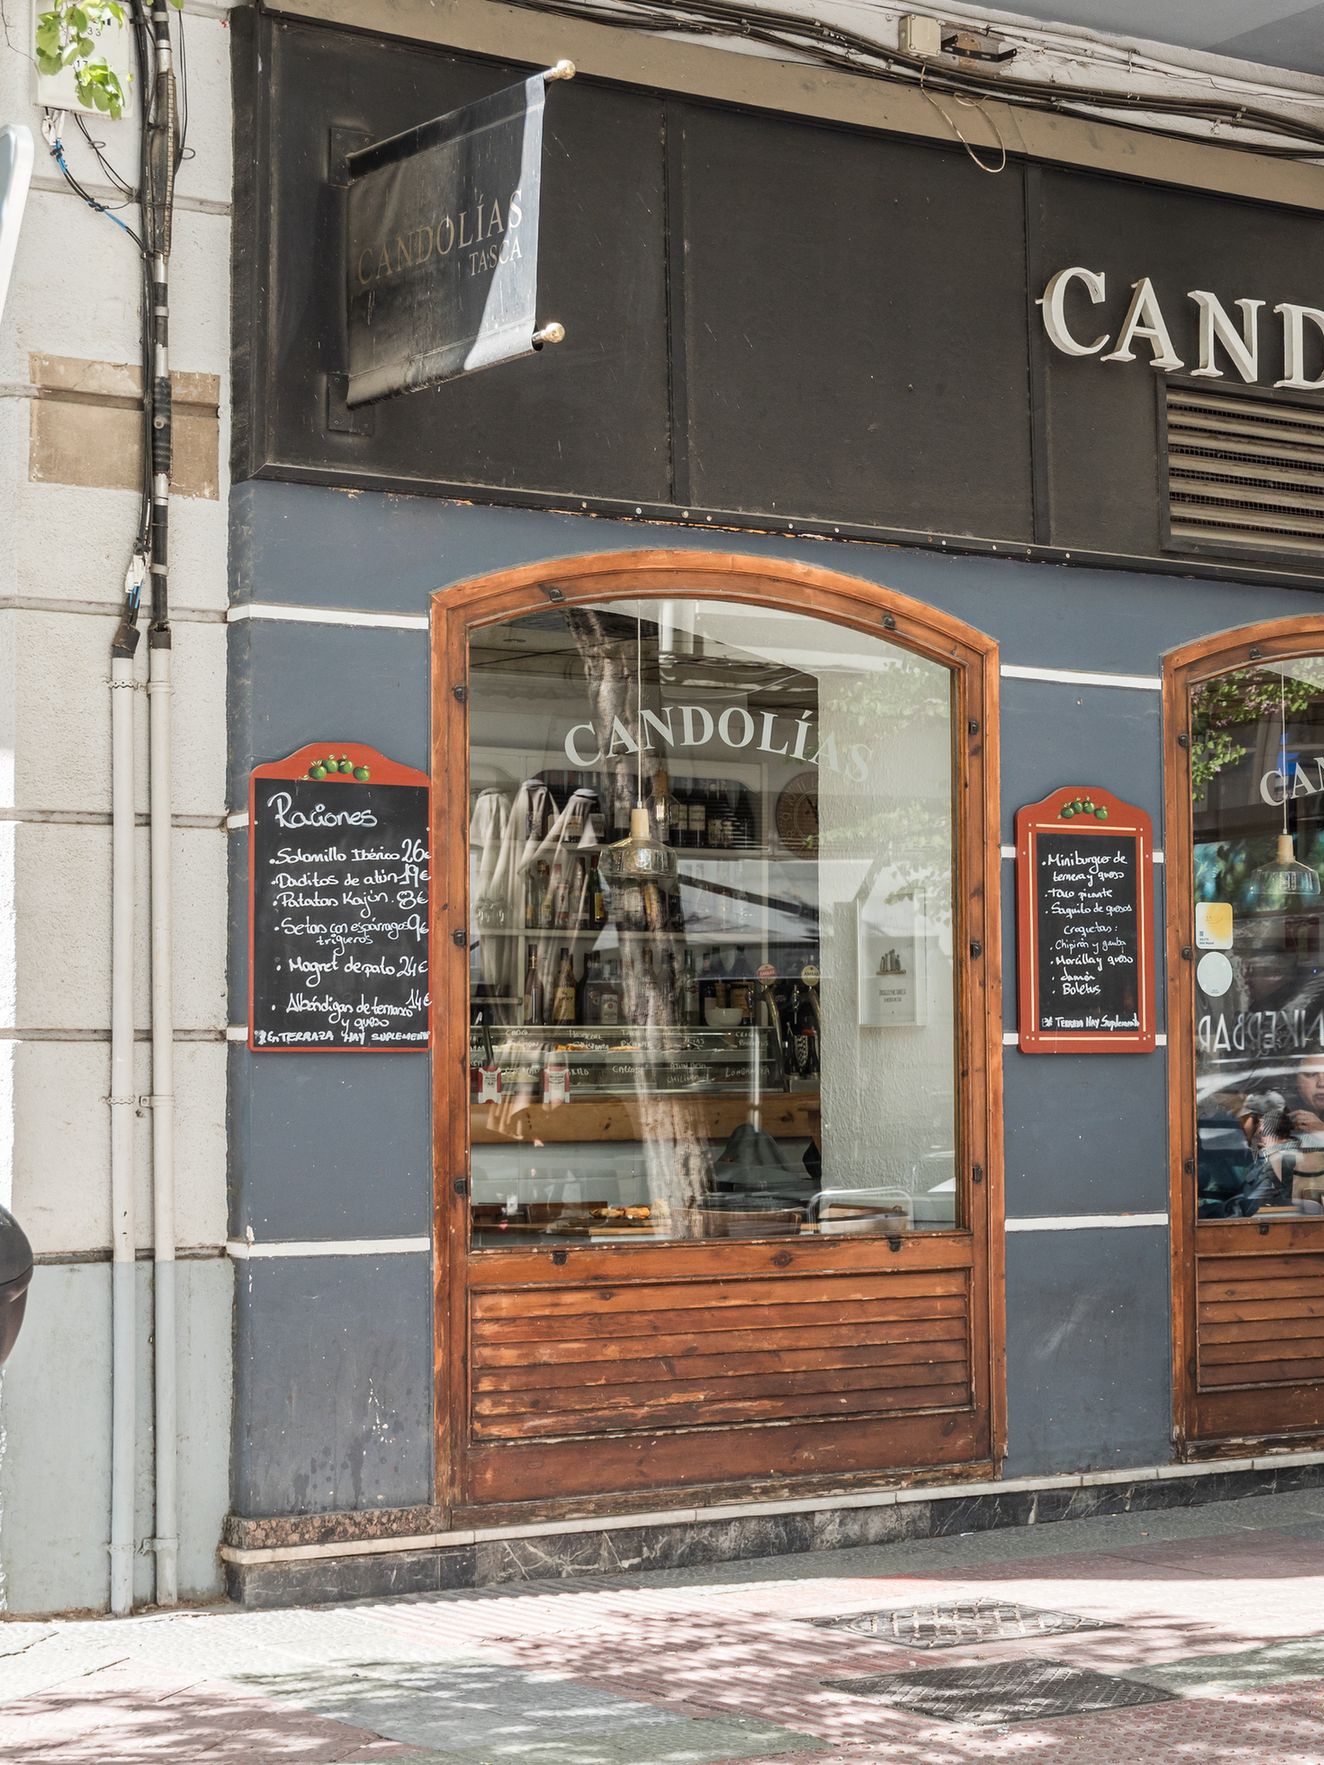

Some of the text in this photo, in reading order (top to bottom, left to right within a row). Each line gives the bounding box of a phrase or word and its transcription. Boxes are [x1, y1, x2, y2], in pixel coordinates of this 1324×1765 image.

[358, 189, 522, 284] CANDOLÍAS
[469, 235, 523, 276] TASCA
[564, 706, 873, 783] CANDOLÍAS
[267, 792, 378, 828] Raciones
[277, 847, 347, 864] Solomillo
[401, 838, 432, 863] 26€
[1113, 850, 1128, 864] de
[276, 872, 339, 889] Daditos
[344, 873, 360, 886] de
[1086, 874, 1093, 887] y
[1098, 871, 1125, 881] queso
[276, 891, 339, 907] Patatas
[396, 890, 428, 909] 8€
[1078, 888, 1113, 901] picante
[1093, 902, 1104, 913] de
[1105, 904, 1132, 917] quesos
[281, 916, 328, 935] Setas
[330, 924, 348, 934] con
[316, 934, 374, 956] trigueros
[1092, 942, 1099, 955] y
[289, 955, 340, 987] Magret
[396, 955, 428, 978] 24€
[1095, 957, 1103, 972] y
[1107, 955, 1134, 966] queso
[1062, 981, 1102, 996] Boletus
[286, 993, 354, 1024] Albóndigas
[341, 1017, 390, 1038] y queso
